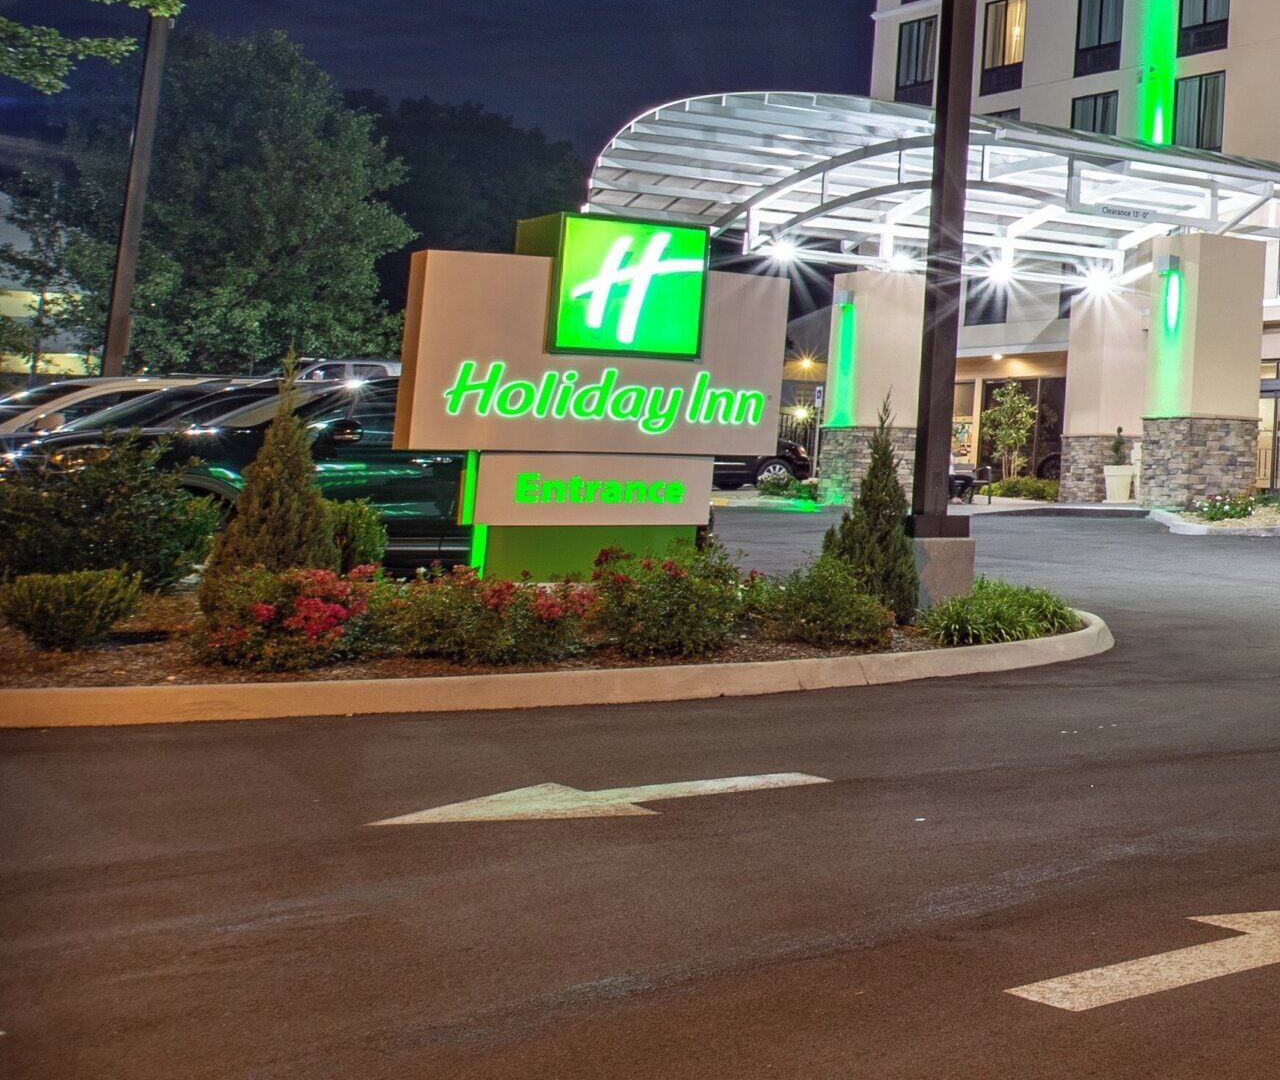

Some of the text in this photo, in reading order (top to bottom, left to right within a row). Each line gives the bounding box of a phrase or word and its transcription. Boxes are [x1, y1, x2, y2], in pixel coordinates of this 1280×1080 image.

[1102, 206, 1131, 218] Clearance
[444, 360, 765, 434] Holiday Inn
[515, 472, 685, 504] Entrance
